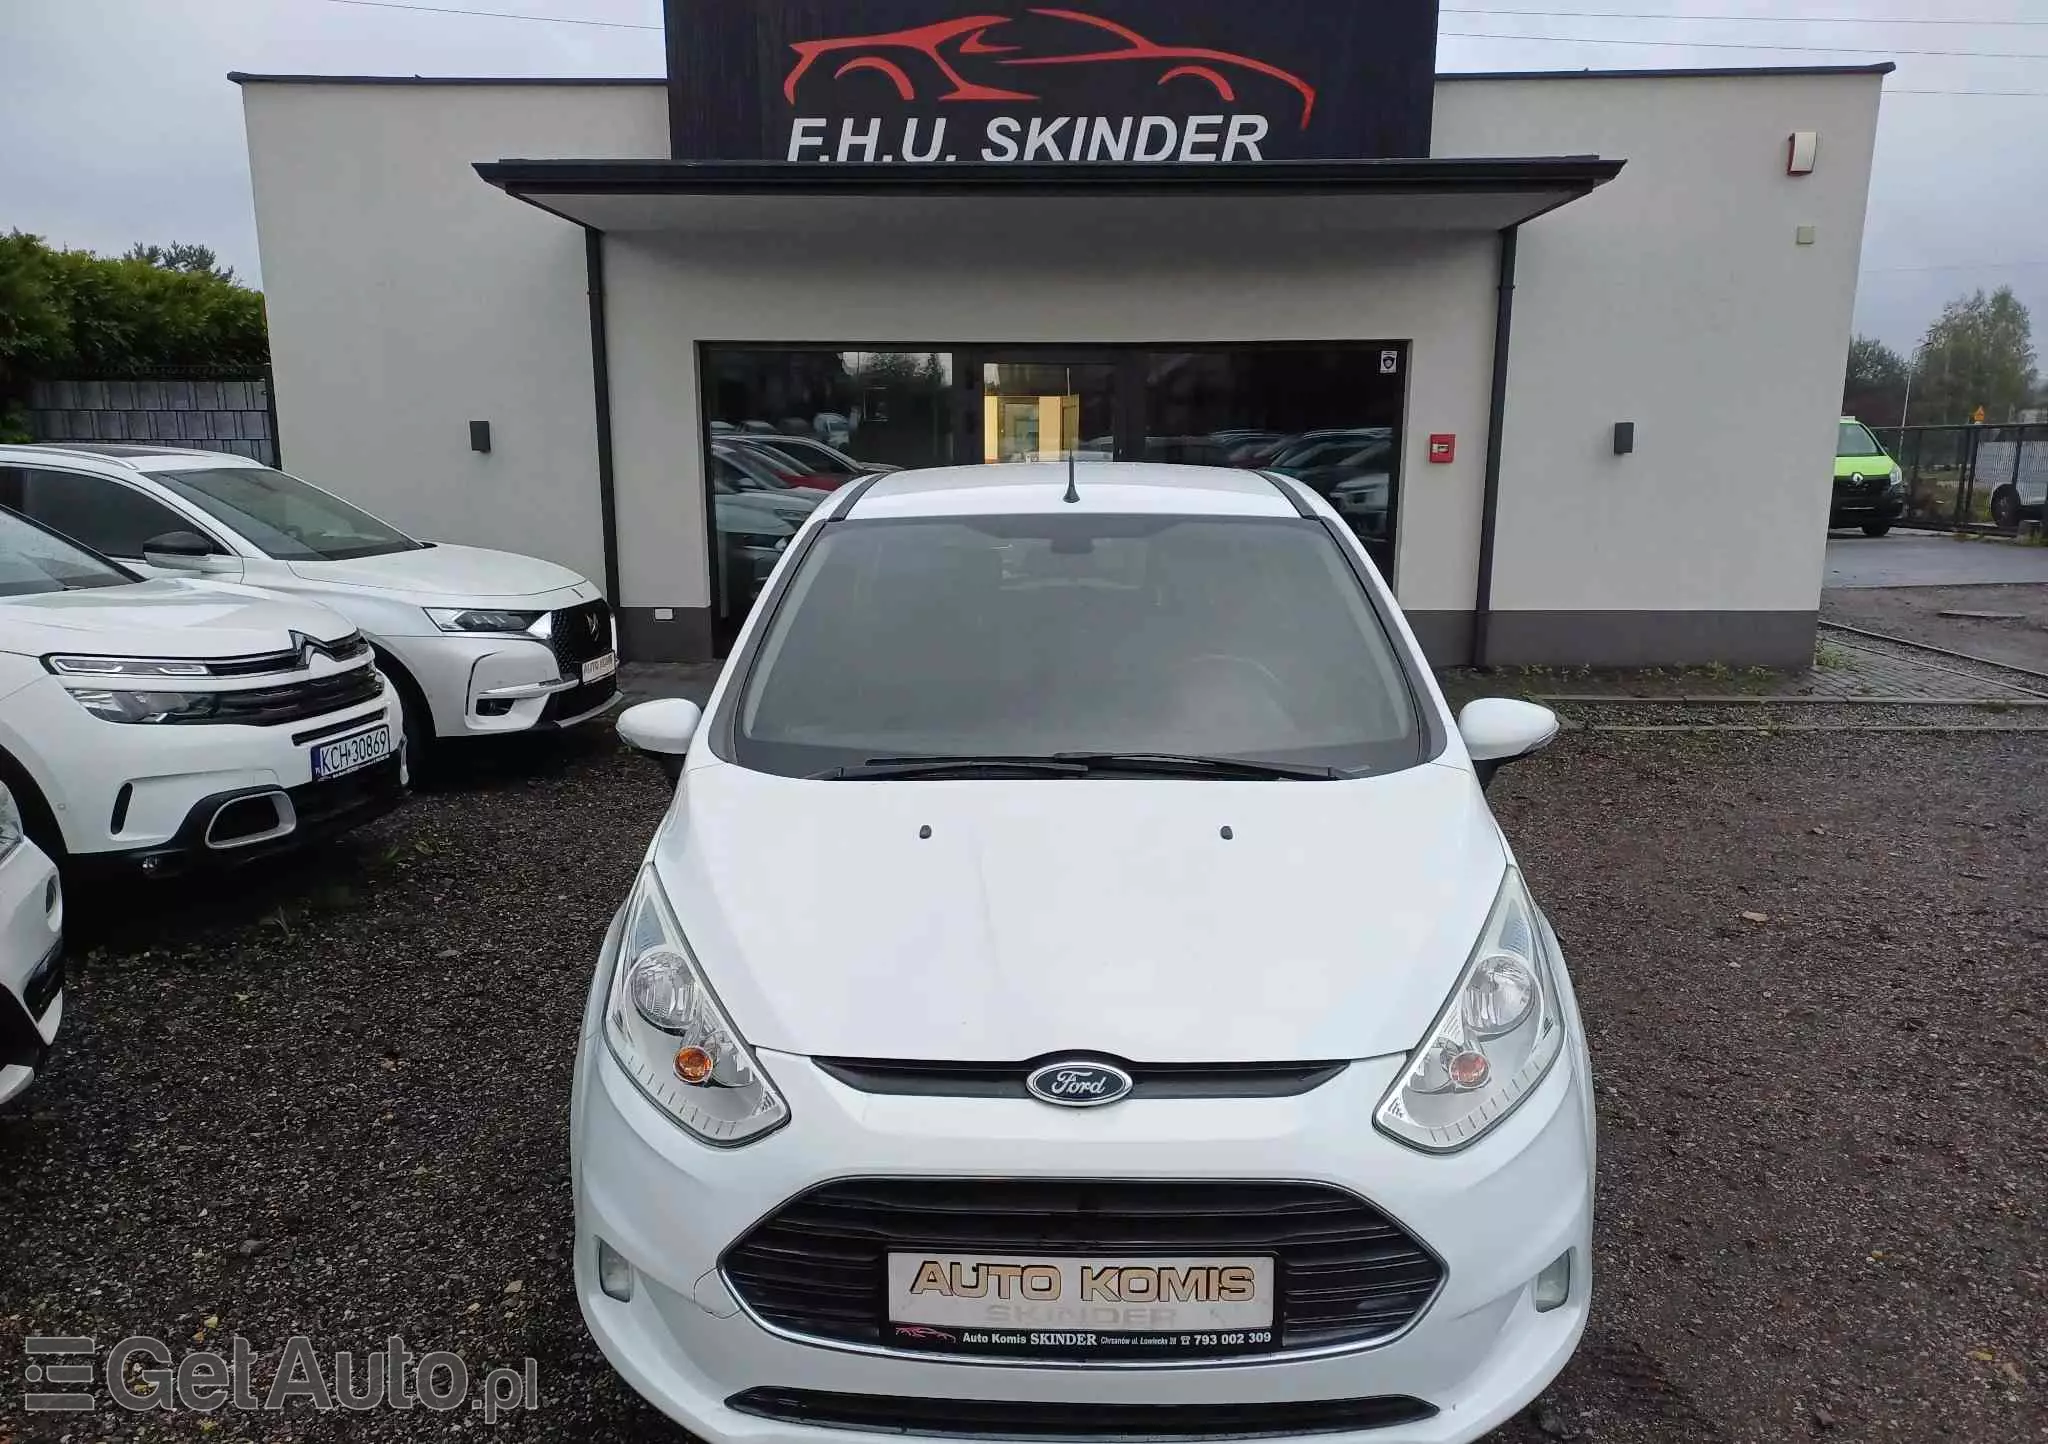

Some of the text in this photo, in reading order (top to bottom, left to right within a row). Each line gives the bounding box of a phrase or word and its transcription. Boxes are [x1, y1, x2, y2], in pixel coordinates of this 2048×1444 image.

[786, 114, 1270, 163] F.H.U. SKINDER
[321, 742, 349, 774] KCH
[351, 730, 387, 763] 30869
[1050, 1069, 1108, 1094] Ford
[909, 1259, 1256, 1303] AUTO KOMIS
[984, 1304, 1178, 1326] SKINDER
[962, 1332, 989, 1344] Auto
[991, 1333, 1027, 1345] Komis
[1030, 1333, 1098, 1346] SKINDER
[1193, 1334, 1218, 1346] 793
[1221, 1333, 1245, 1345] 002
[1248, 1331, 1272, 1344] 309
